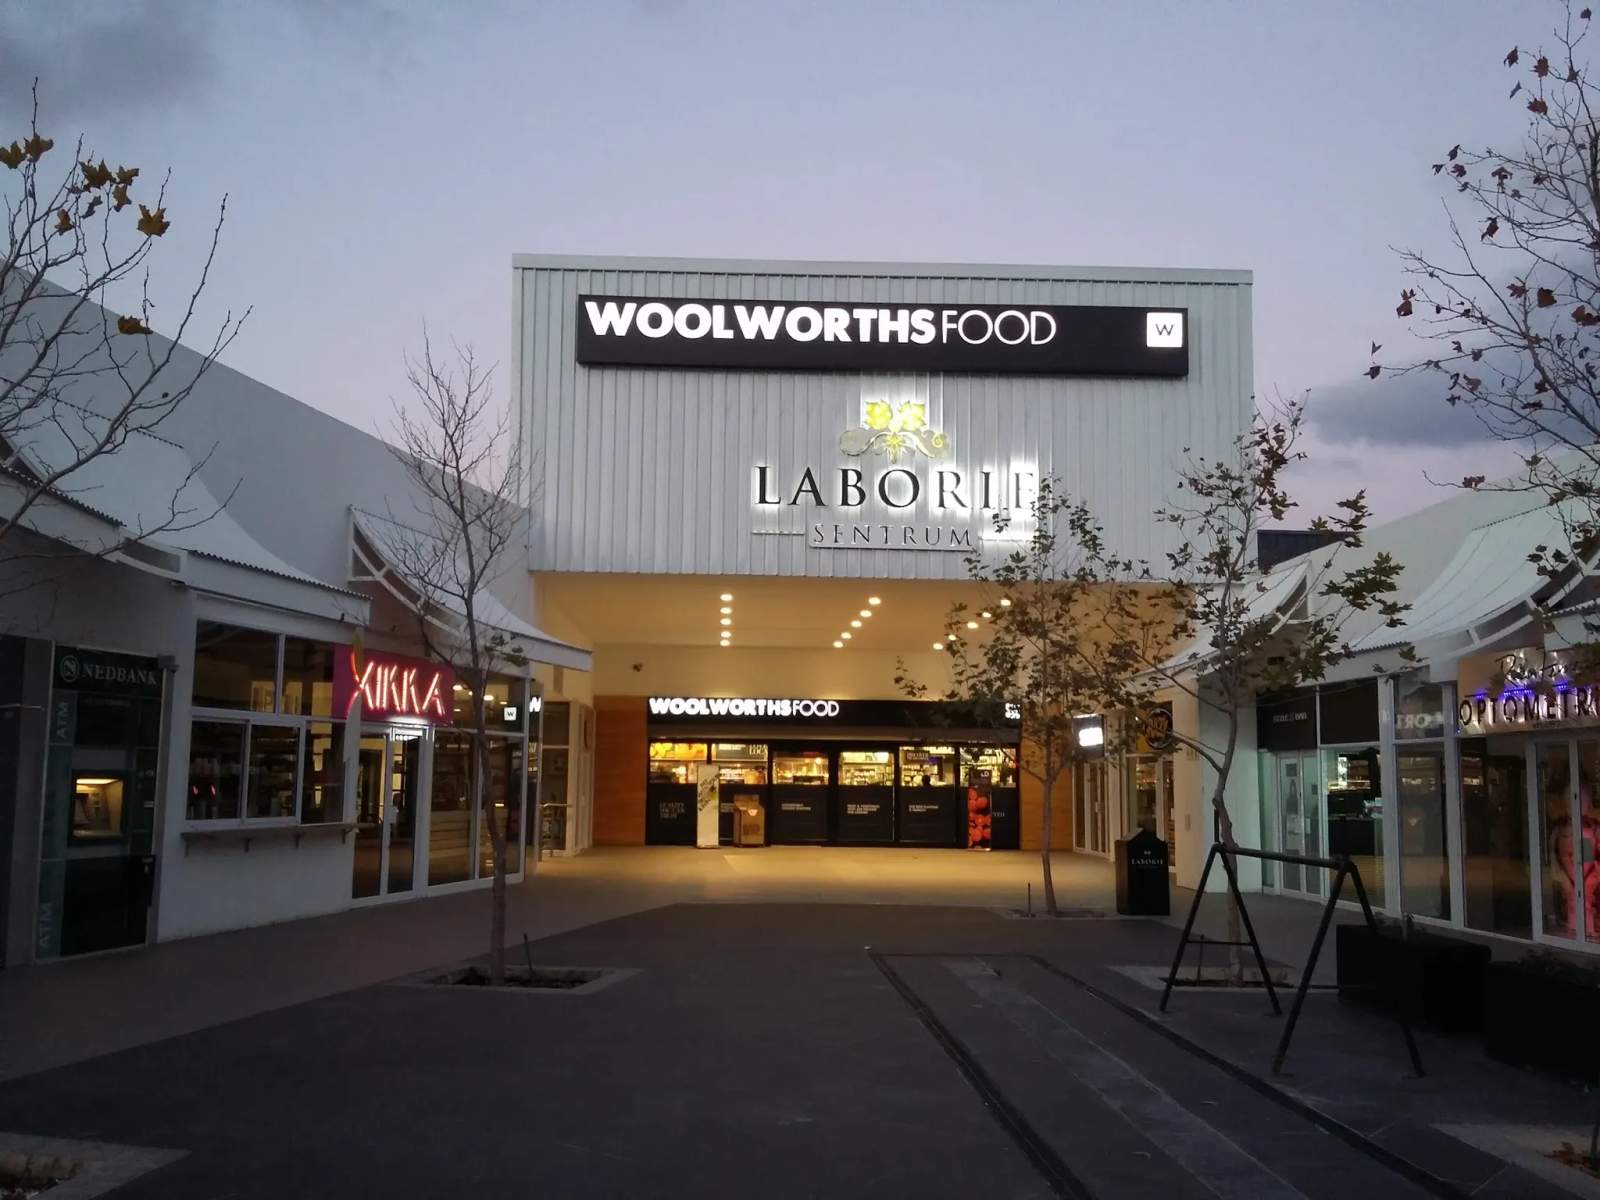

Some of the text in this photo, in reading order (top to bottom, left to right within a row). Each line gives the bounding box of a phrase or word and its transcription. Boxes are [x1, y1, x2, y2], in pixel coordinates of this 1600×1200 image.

[814, 524, 972, 547] SENTRUM
[81, 664, 158, 686] NEDBANK
[56, 701, 69, 739] ATM
